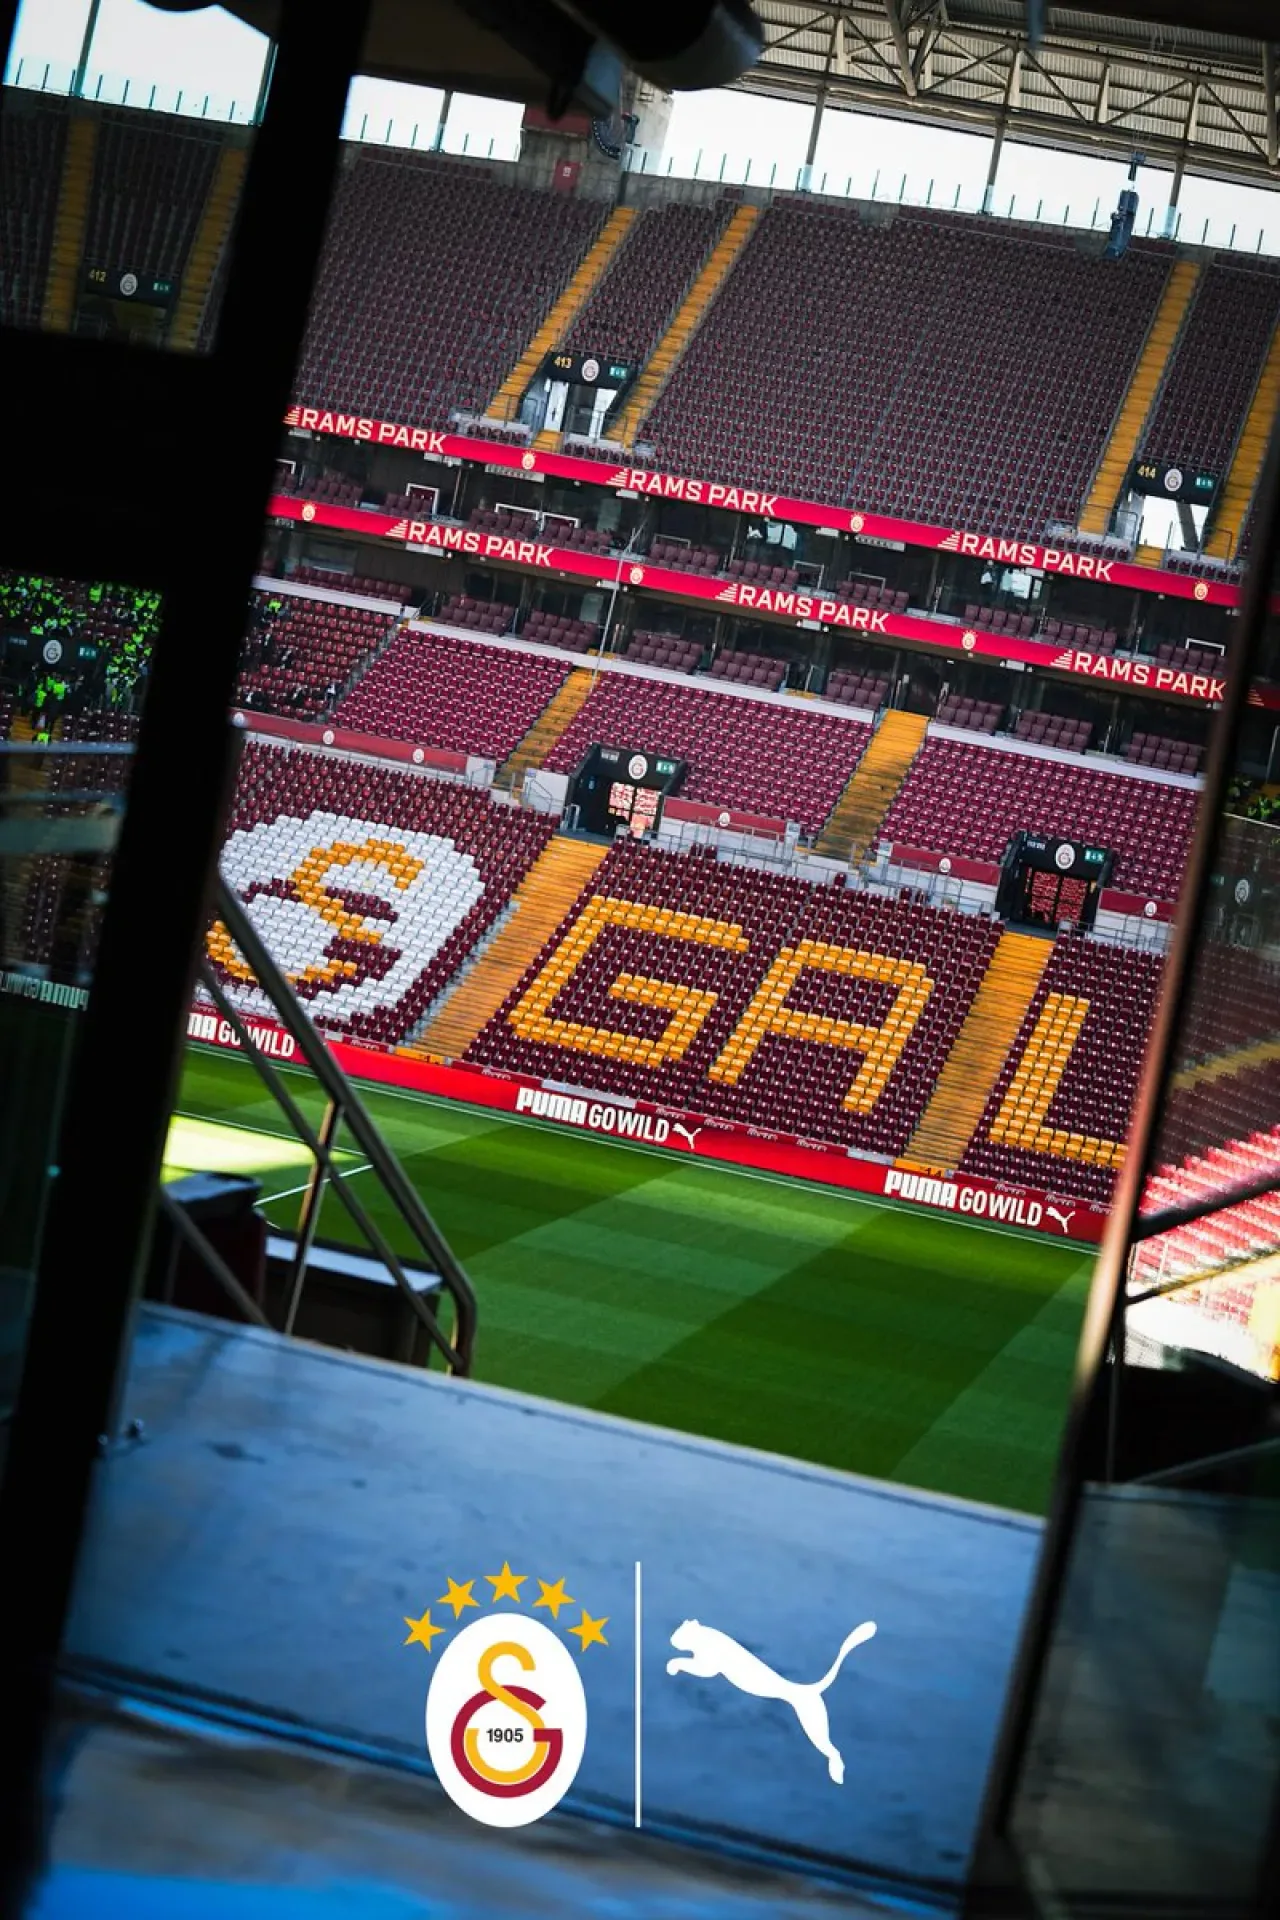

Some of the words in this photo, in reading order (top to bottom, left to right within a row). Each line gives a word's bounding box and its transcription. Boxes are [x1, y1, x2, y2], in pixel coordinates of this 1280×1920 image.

[301, 409, 373, 439] RAMS
[378, 423, 447, 453] PARK
[629, 470, 703, 501] RAMS
[708, 485, 778, 515] PARK
[1137, 465, 1157, 479] 414
[409, 522, 480, 551] RAMS
[486, 537, 553, 566] PARK
[962, 533, 1036, 566] RAMS
[1042, 549, 1114, 581] PARK
[739, 587, 812, 617] RAMS
[818, 602, 890, 632] PARK
[1074, 655, 1149, 685] RAMS
[1156, 669, 1227, 700] PARK
[515, 1087, 587, 1125] PUMA
[884, 1169, 957, 1209] PUMA
